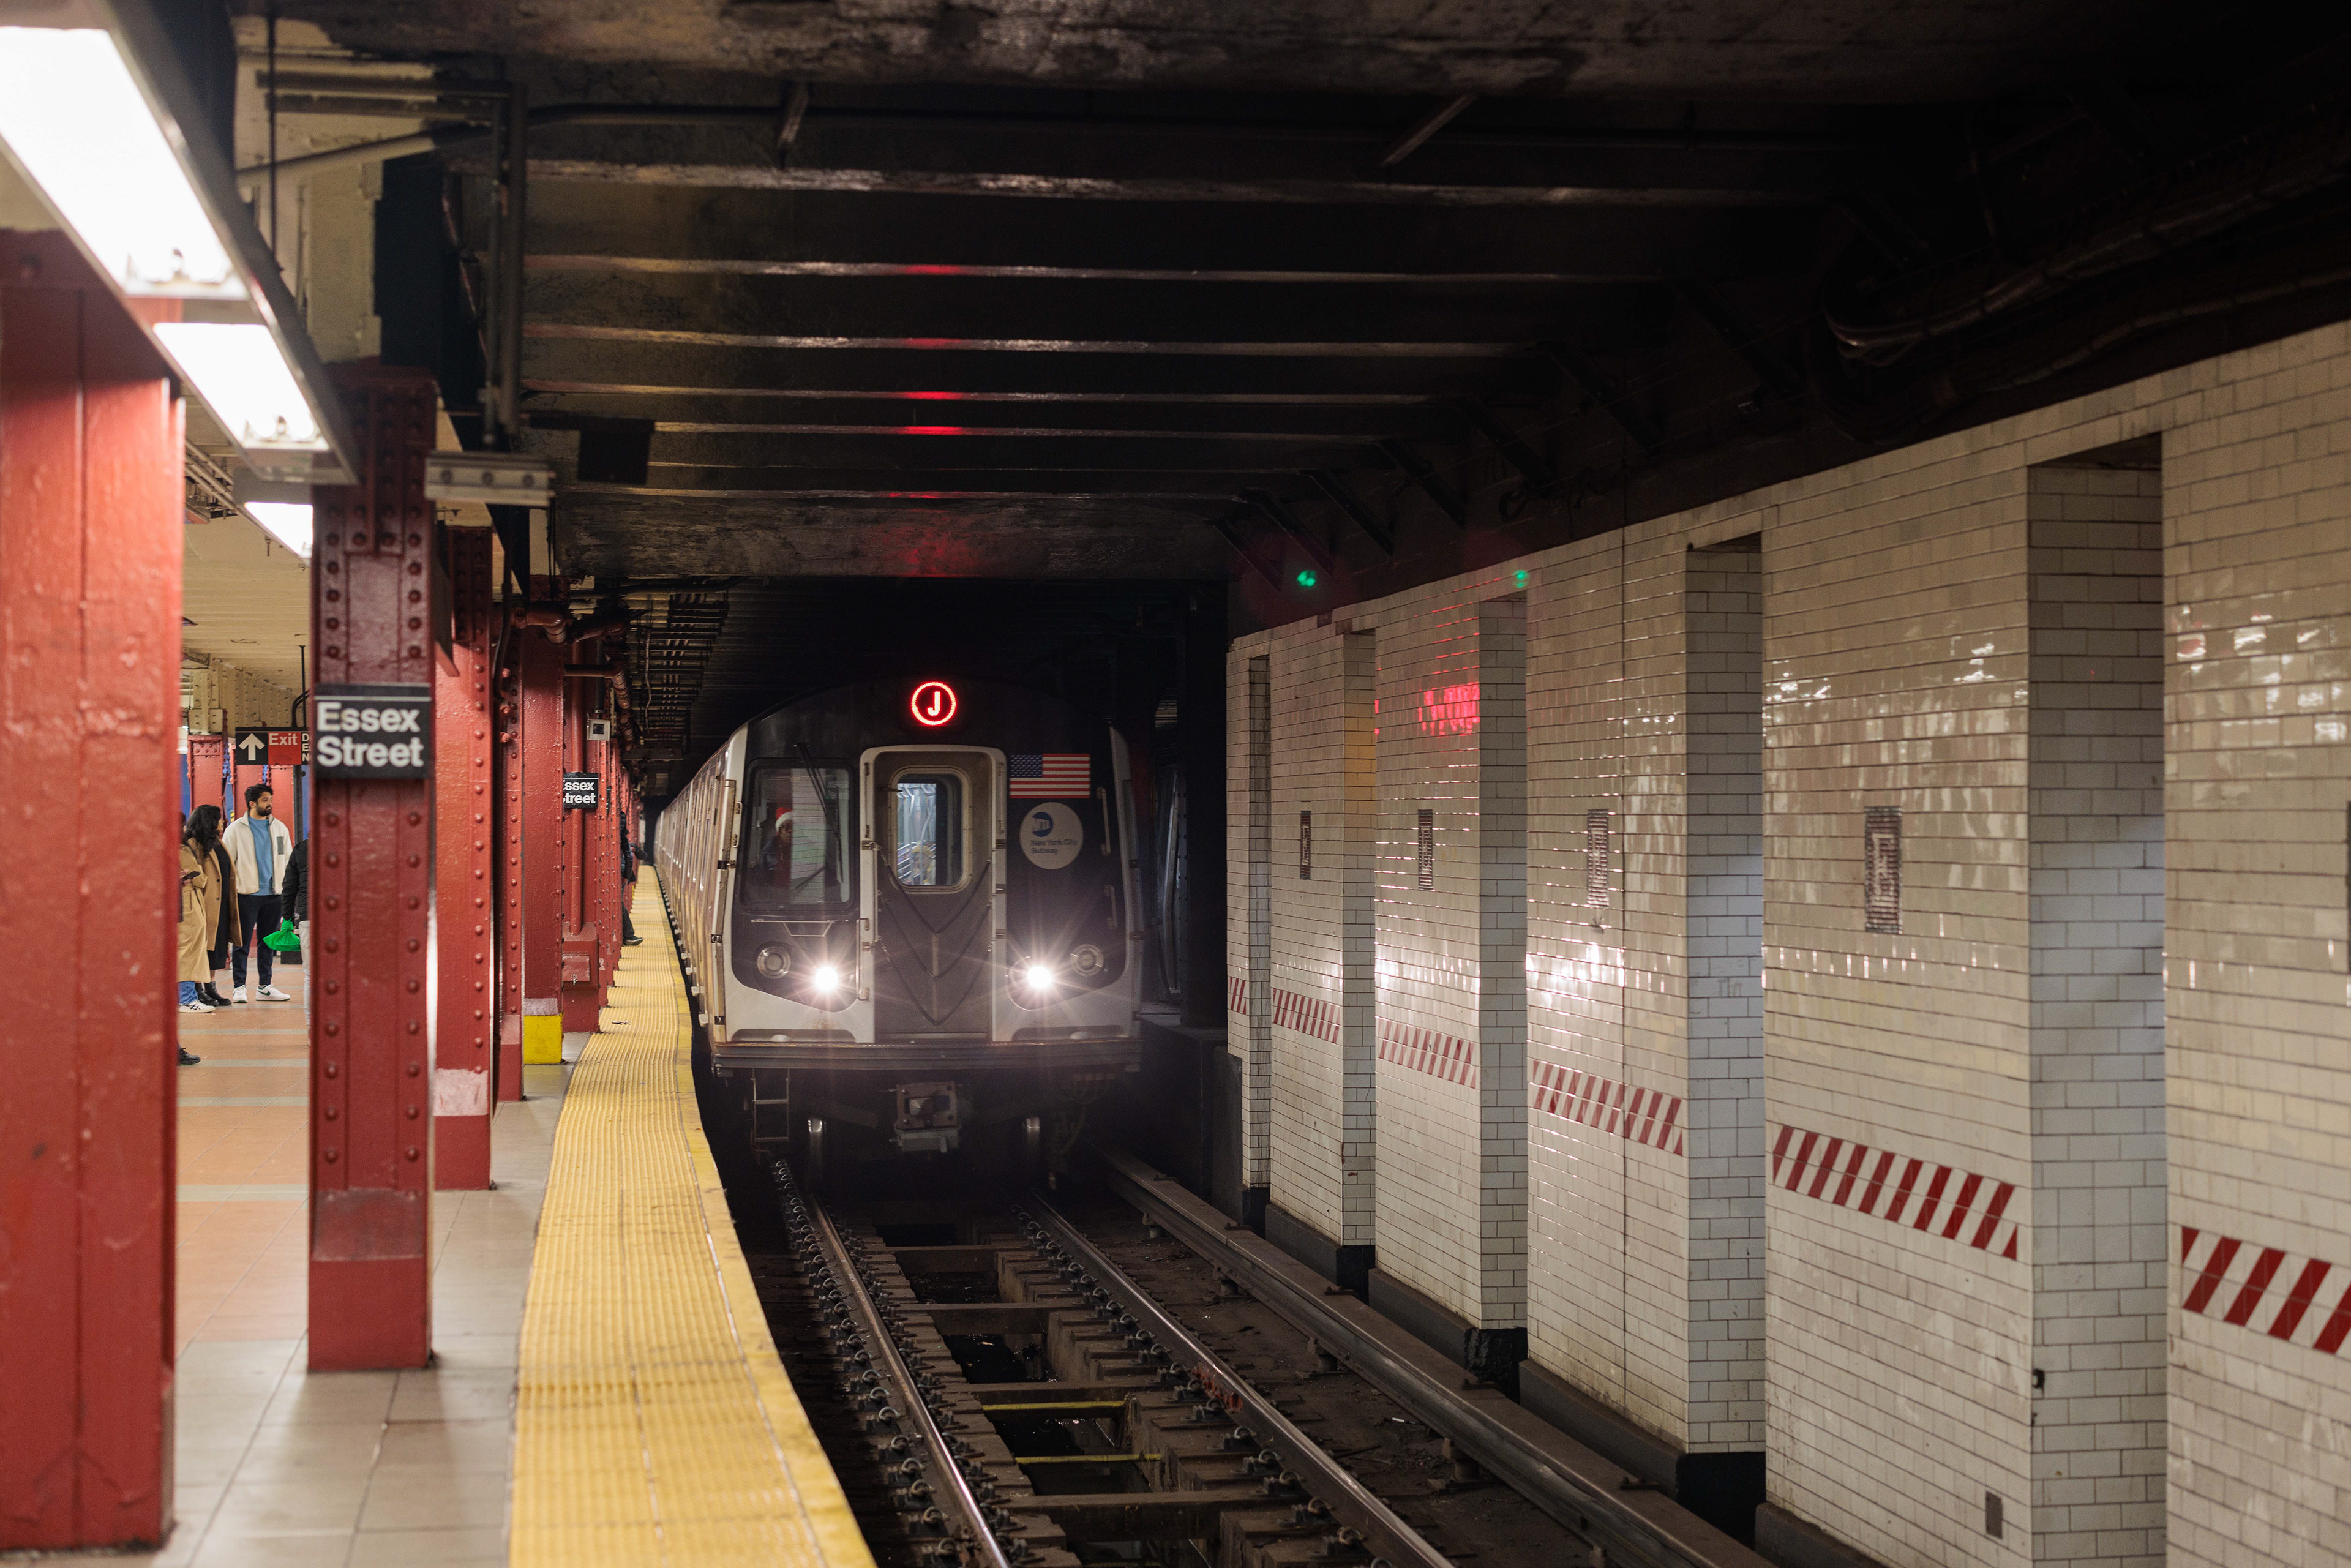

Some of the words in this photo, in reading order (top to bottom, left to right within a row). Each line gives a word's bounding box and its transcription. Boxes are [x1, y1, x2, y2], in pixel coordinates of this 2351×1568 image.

[927, 691, 940, 716] J
[317, 702, 421, 732] Essex
[269, 733, 298, 746] Exit
[317, 735, 424, 767] Street
[563, 780, 594, 790] ssex
[563, 793, 596, 803] treet
